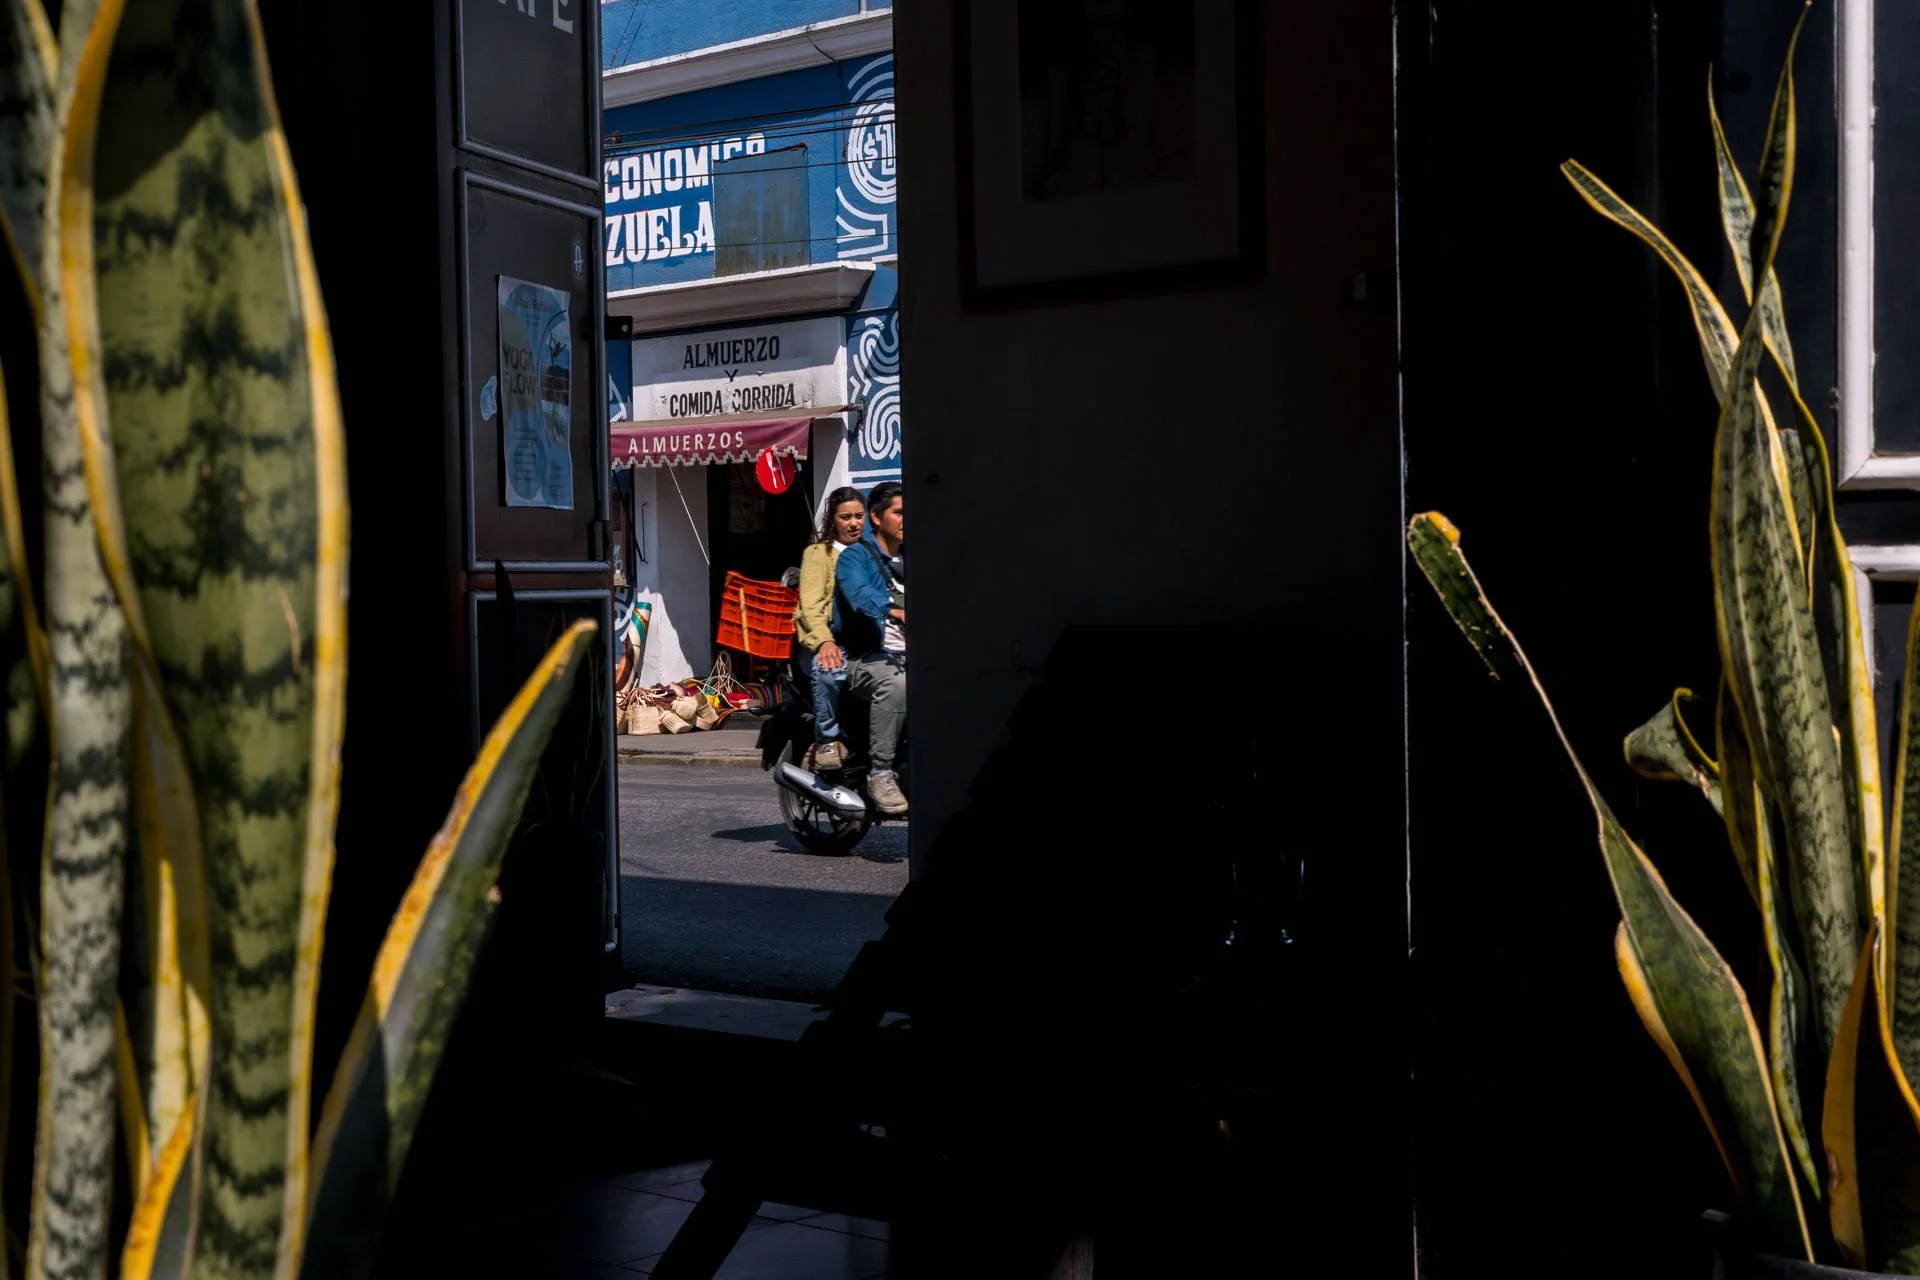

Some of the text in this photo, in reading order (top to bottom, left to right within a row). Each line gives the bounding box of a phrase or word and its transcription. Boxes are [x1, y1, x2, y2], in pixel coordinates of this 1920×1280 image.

[606, 201, 715, 266] ZUELA
[683, 335, 780, 369] ALMUERZO
[724, 369, 739, 382] Y
[669, 383, 796, 417] COMIDA CORRIDA
[628, 431, 744, 454] ALMUERZOS
